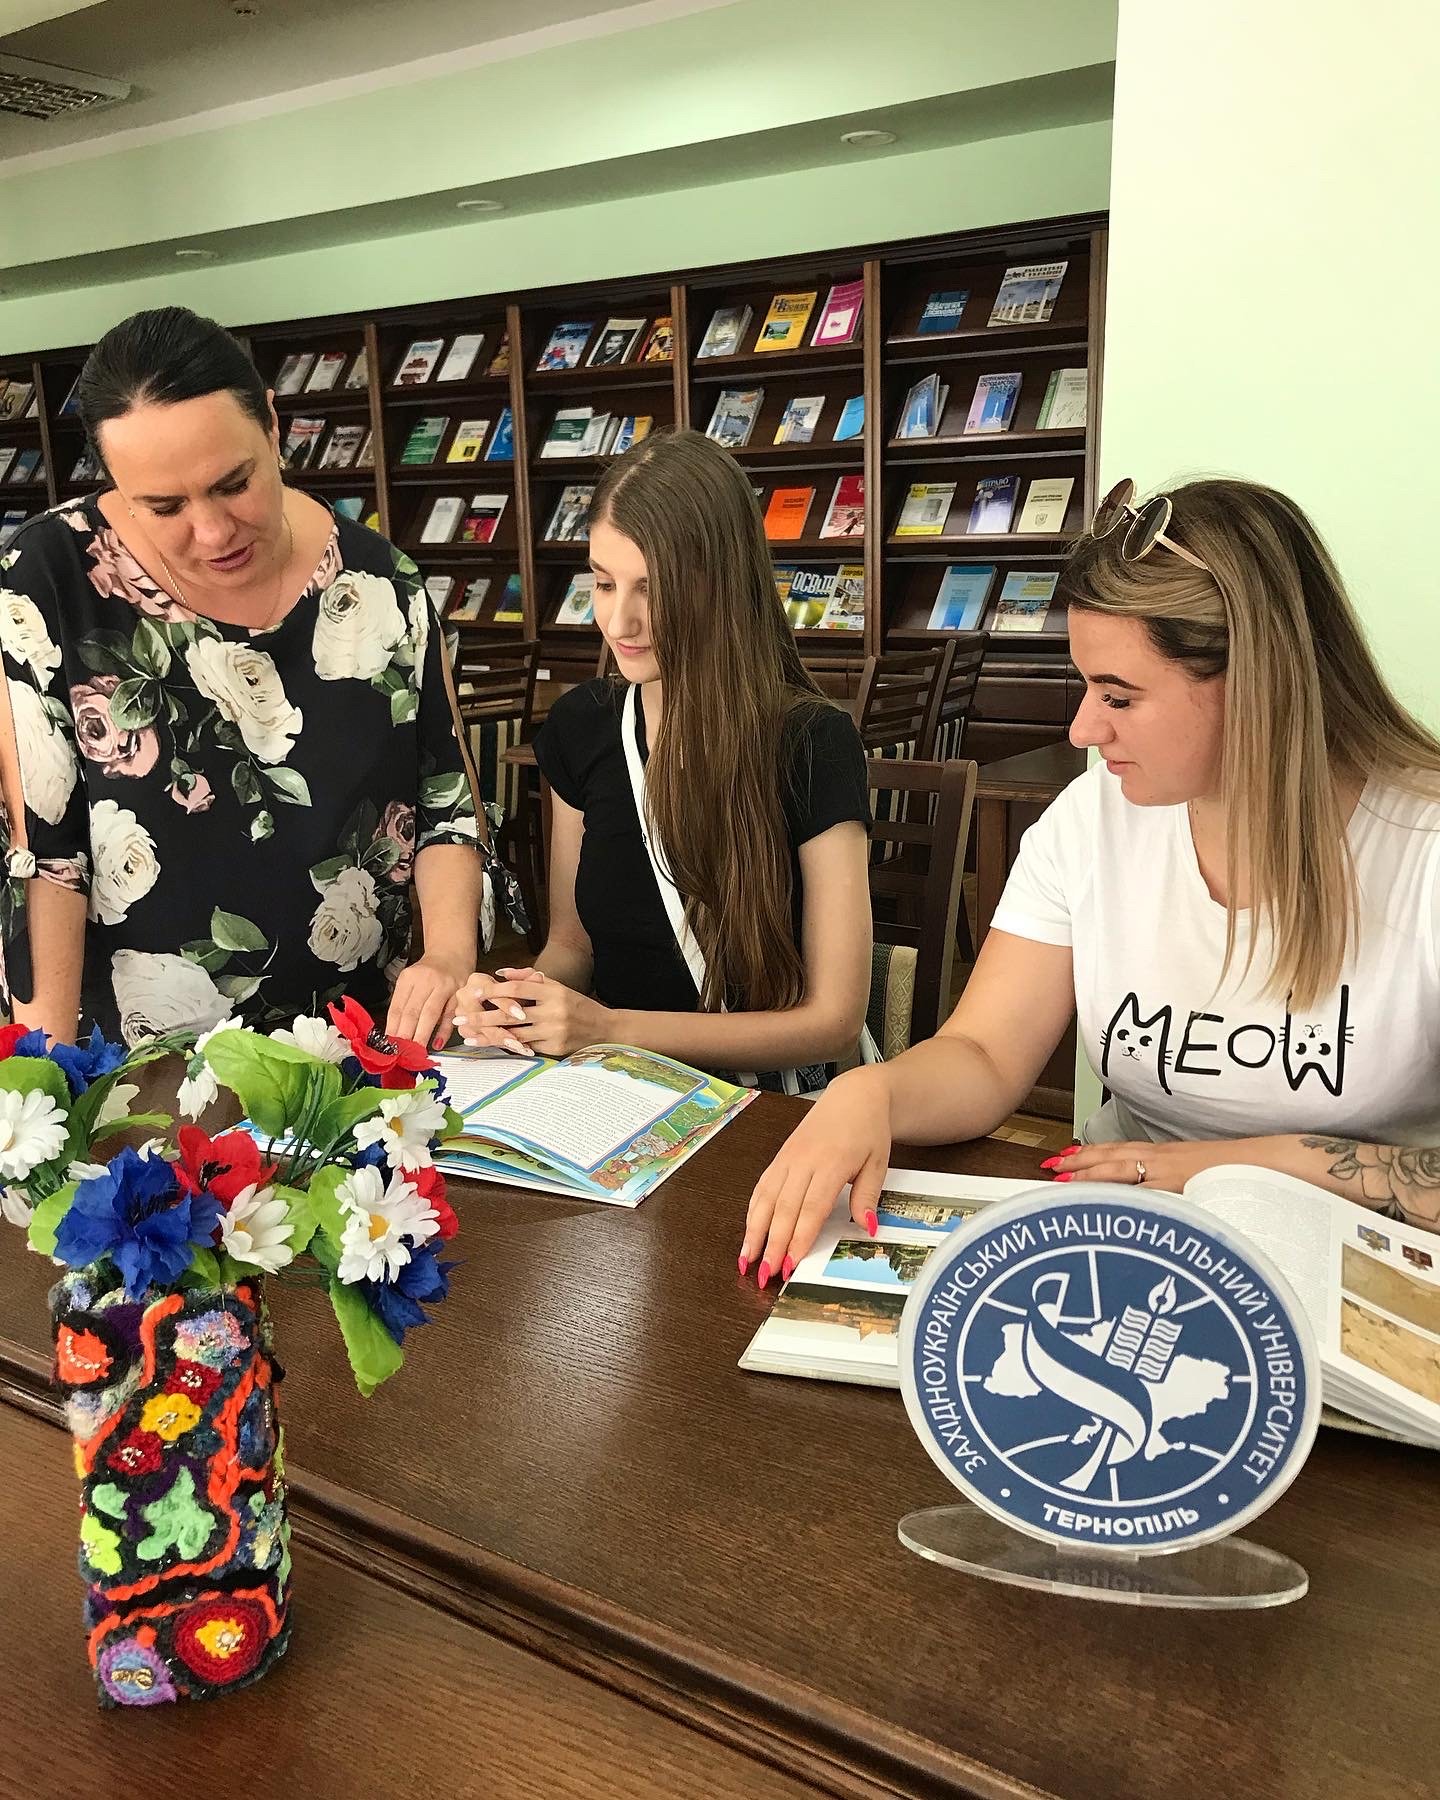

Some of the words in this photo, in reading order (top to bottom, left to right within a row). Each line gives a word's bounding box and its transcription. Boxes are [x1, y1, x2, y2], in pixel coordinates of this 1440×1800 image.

[1100, 984, 1353, 1096] MEOW
[922, 1224, 1036, 1474] ЗАХІДНОУКРАЇНСЬКИЙ
[1038, 1212, 1269, 1316] НАЦІОНАЛЬНИЙ
[1243, 1314, 1297, 1484] УНІВЕРСИТЕТ
[1042, 1503, 1200, 1536] ТЕРНОПІЛЬ
